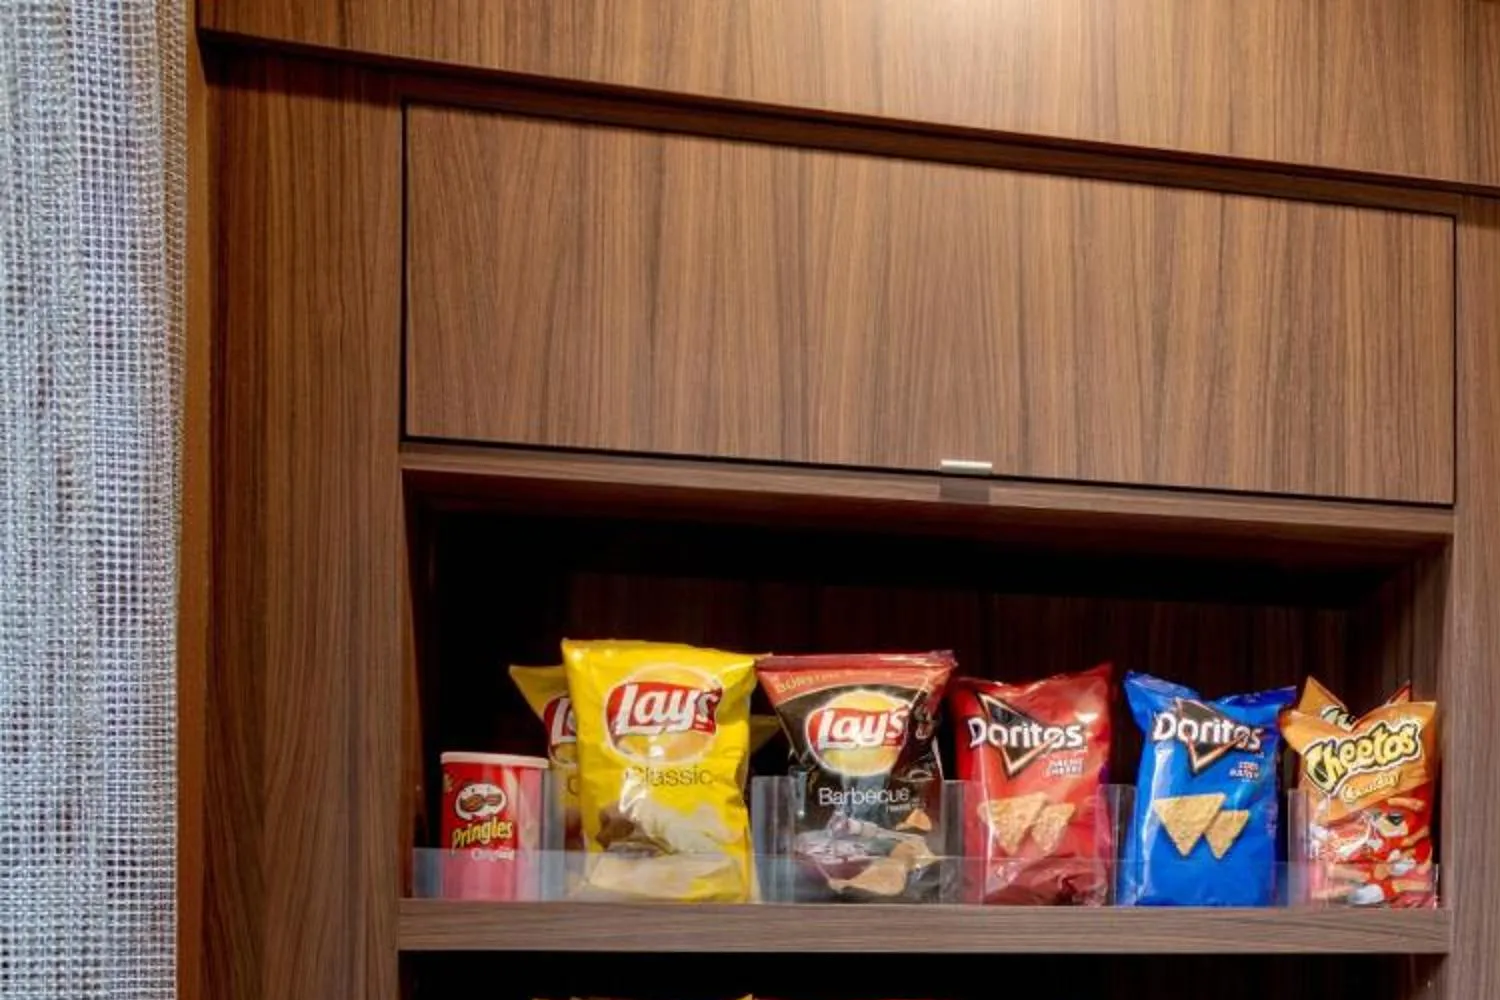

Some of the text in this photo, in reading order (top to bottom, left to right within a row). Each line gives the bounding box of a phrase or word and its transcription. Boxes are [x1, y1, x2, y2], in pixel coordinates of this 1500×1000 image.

[967, 716, 1084, 749] Doritos
[1153, 712, 1265, 751] Doritos
[1305, 722, 1419, 793] Cheetos
[818, 787, 911, 806] Barbecue
[450, 815, 514, 857] Pringles
